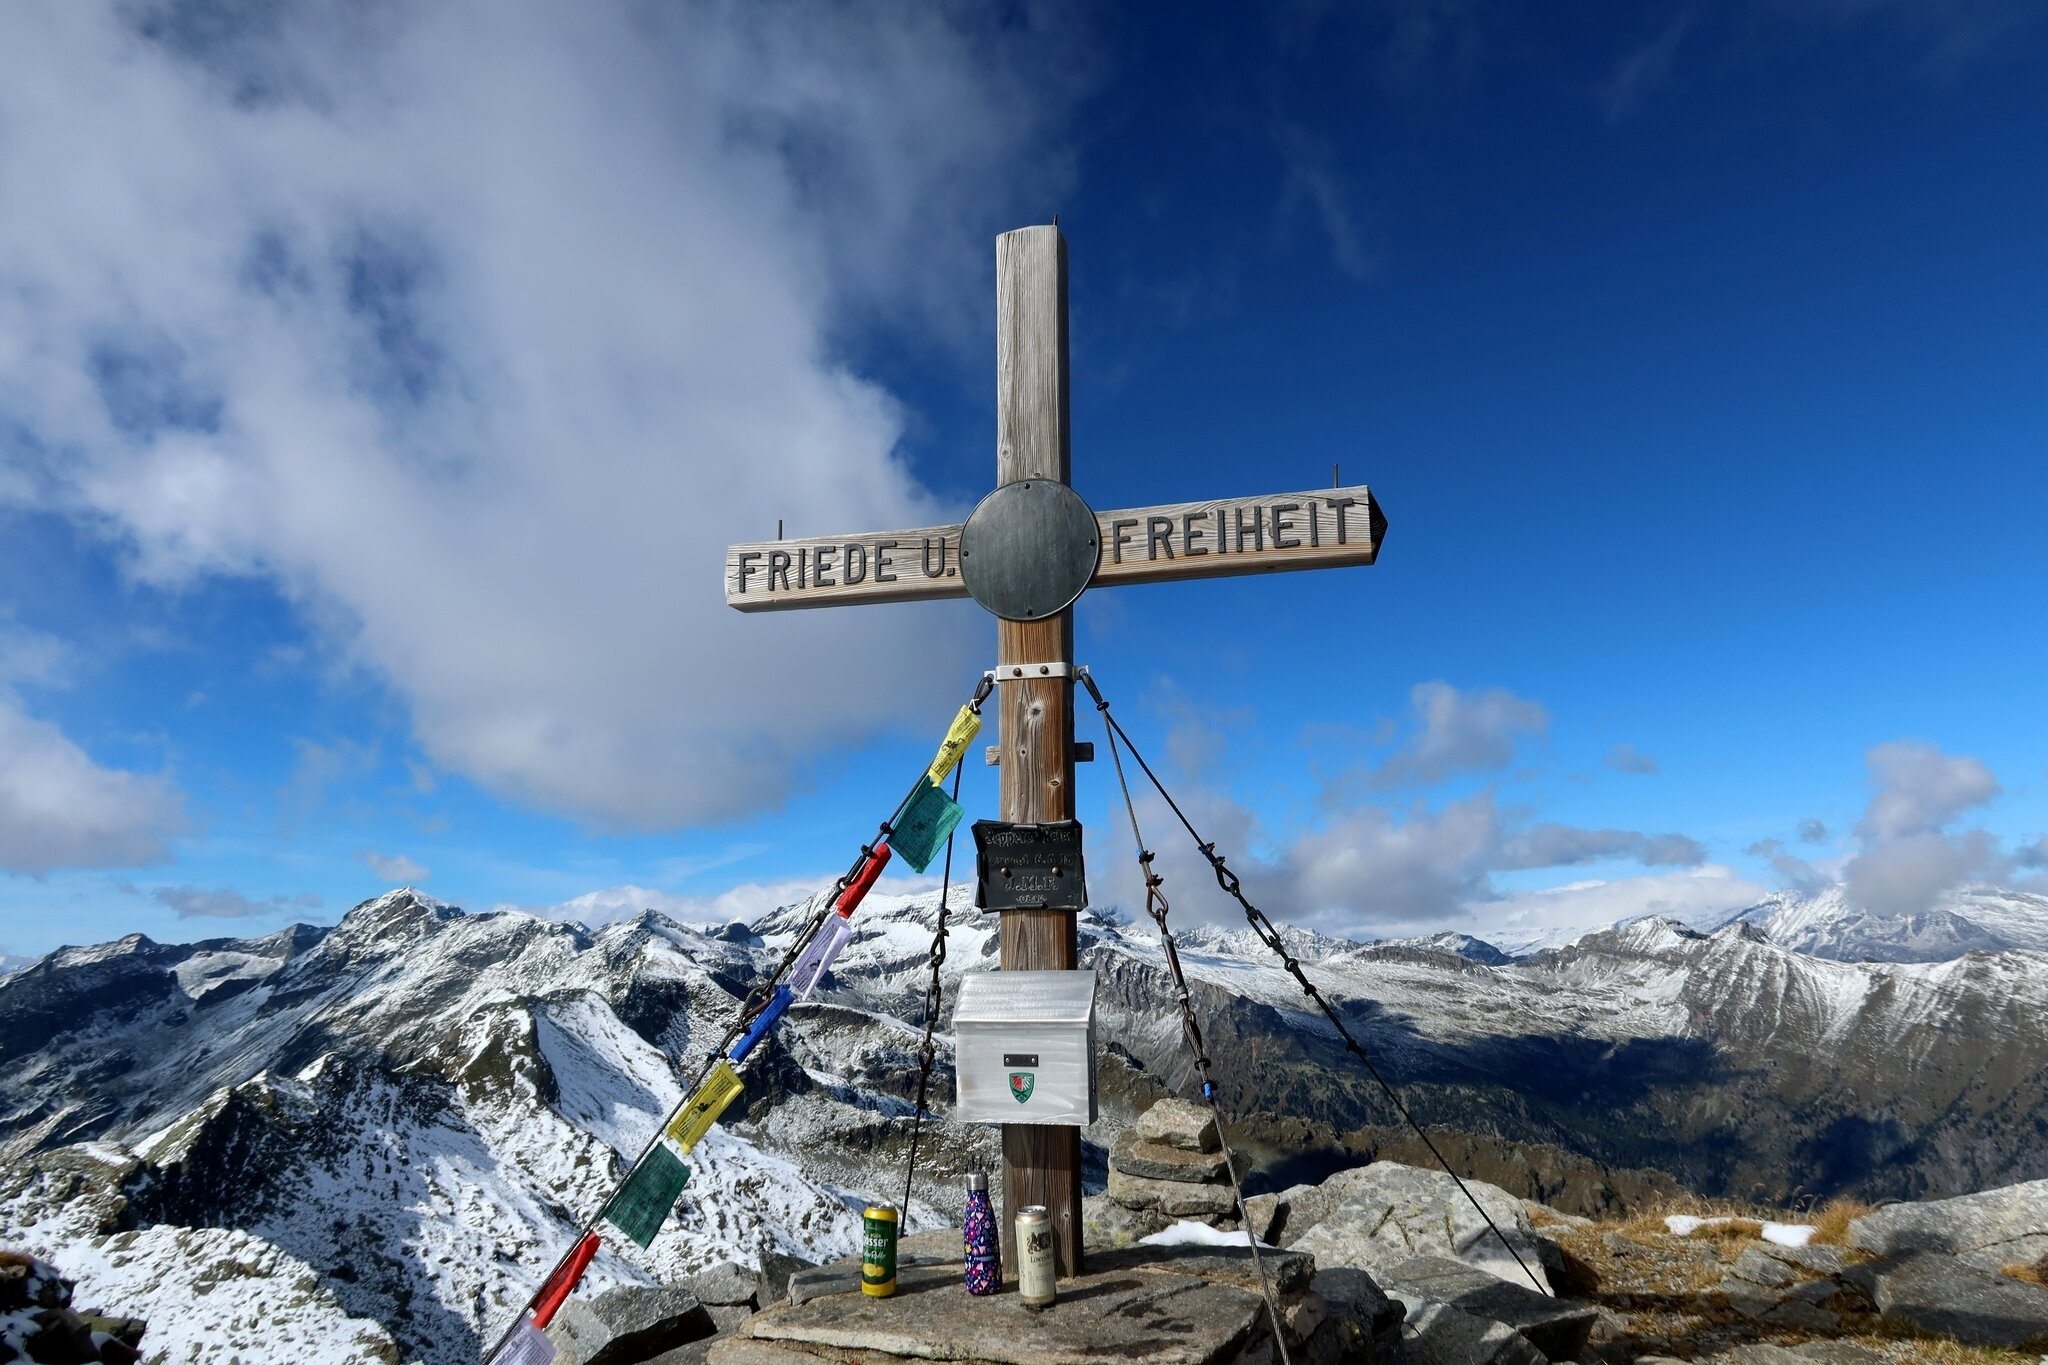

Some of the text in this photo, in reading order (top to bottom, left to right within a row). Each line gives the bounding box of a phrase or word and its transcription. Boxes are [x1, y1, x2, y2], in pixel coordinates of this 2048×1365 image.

[738, 497, 1353, 593] FRIEDE U. FREIHEIT
